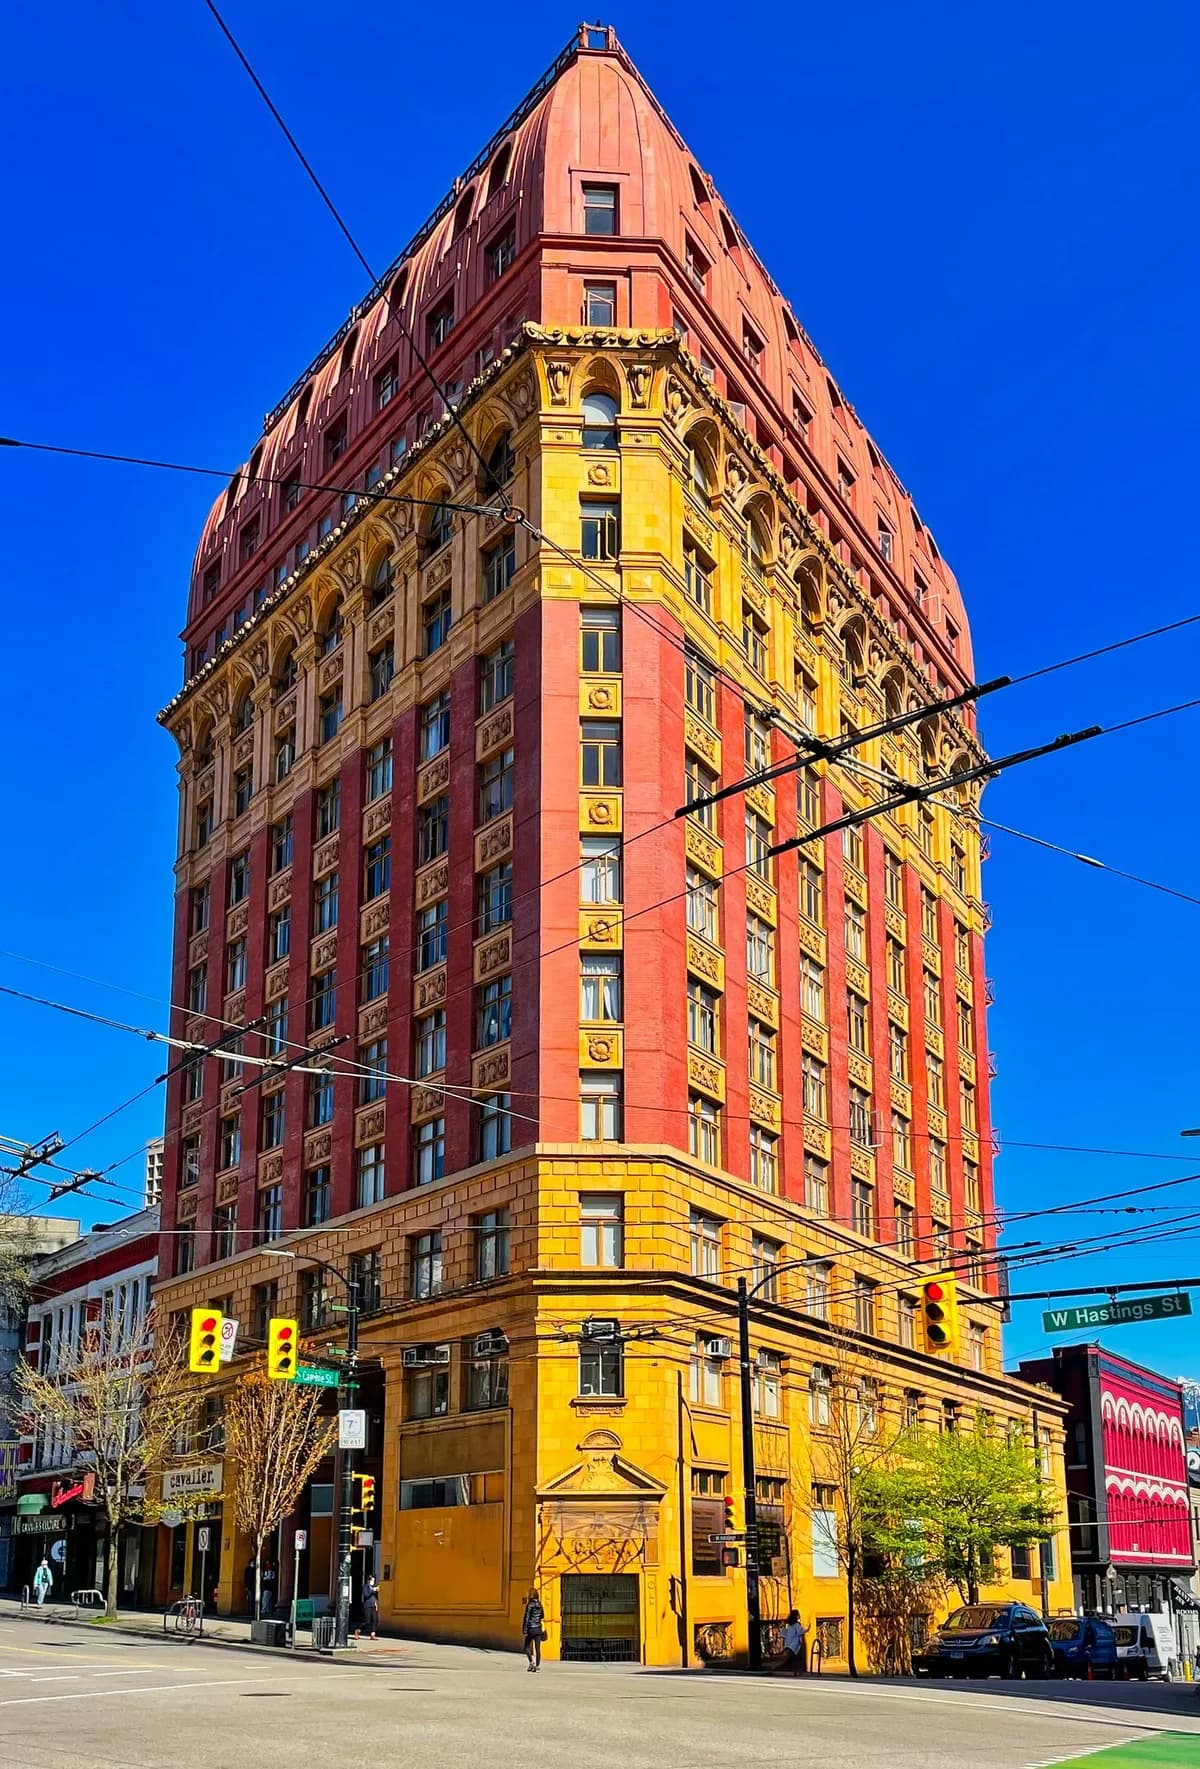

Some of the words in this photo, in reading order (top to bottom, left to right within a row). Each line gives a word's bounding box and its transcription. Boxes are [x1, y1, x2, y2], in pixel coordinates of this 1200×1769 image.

[1051, 1311, 1067, 1327] W
[1075, 1302, 1153, 1324] Hastings
[1161, 1296, 1182, 1312] St
